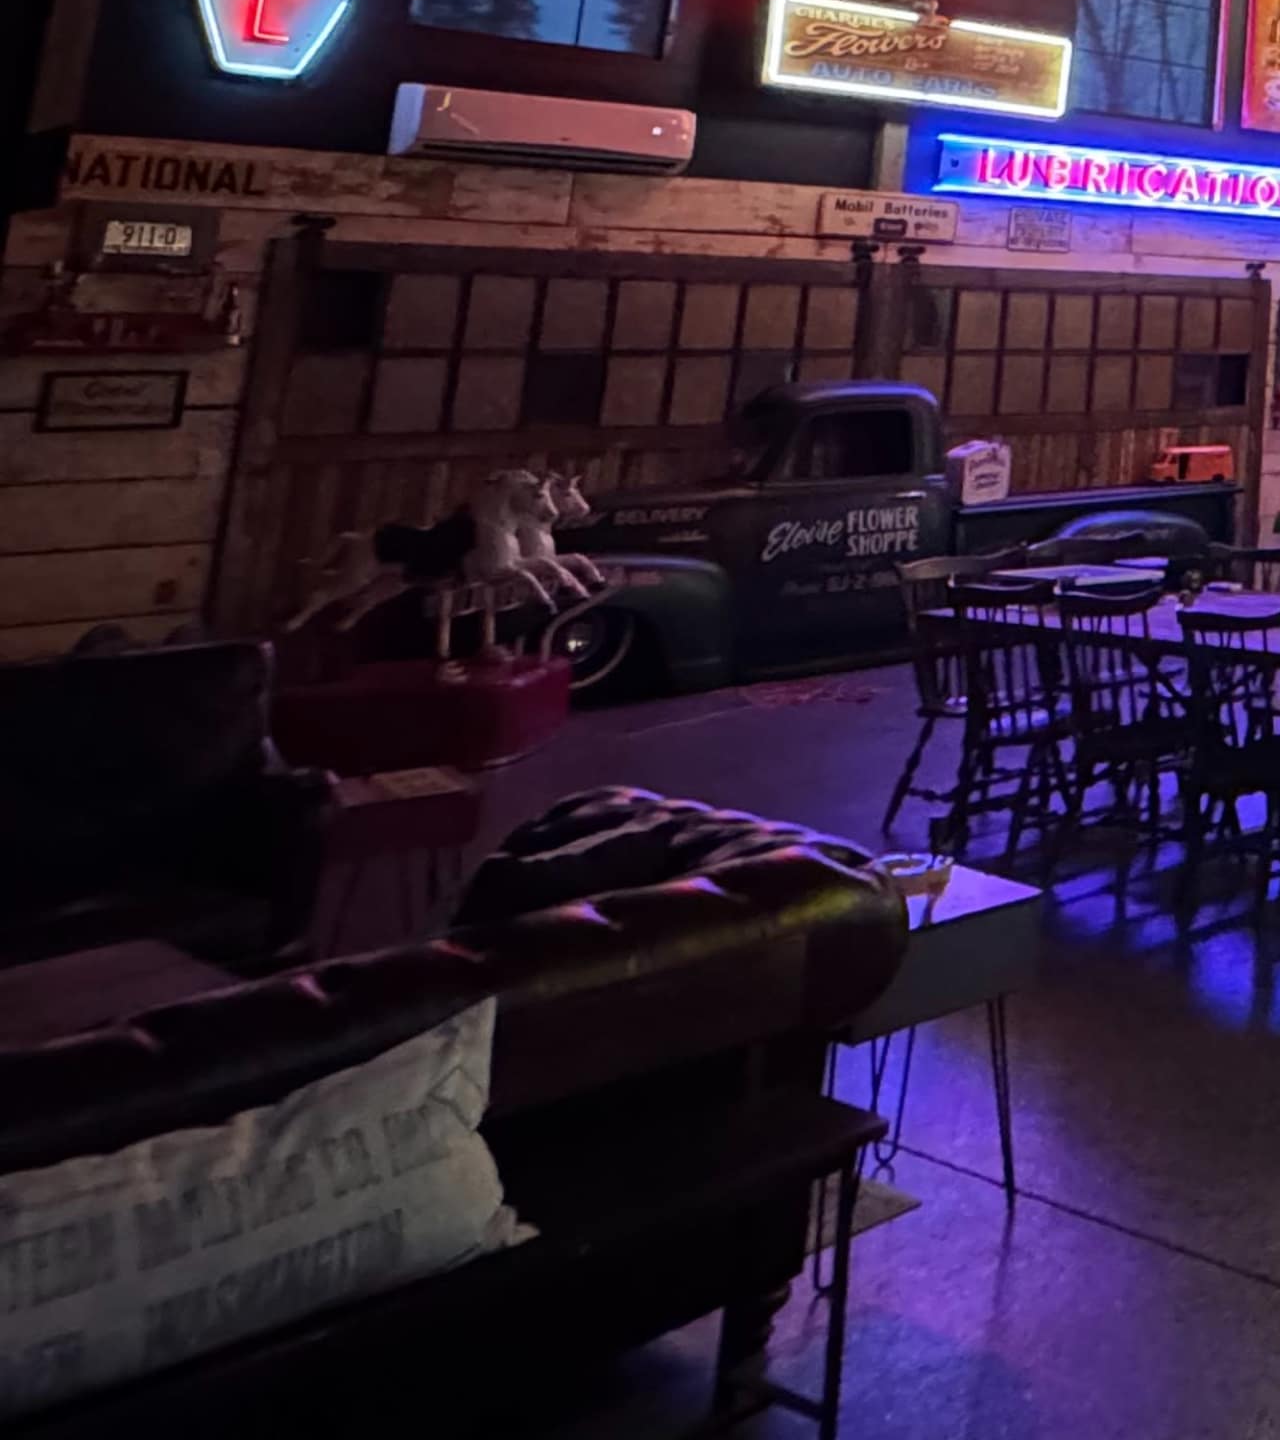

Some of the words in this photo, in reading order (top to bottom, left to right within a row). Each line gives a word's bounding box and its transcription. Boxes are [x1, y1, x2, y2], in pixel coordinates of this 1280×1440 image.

[784, 22, 948, 57] Flowers
[834, 198, 874, 213] Mobil
[883, 202, 949, 220] Batteries
[847, 505, 920, 534] FLOWER
[845, 529, 920, 558] SHOPPE
